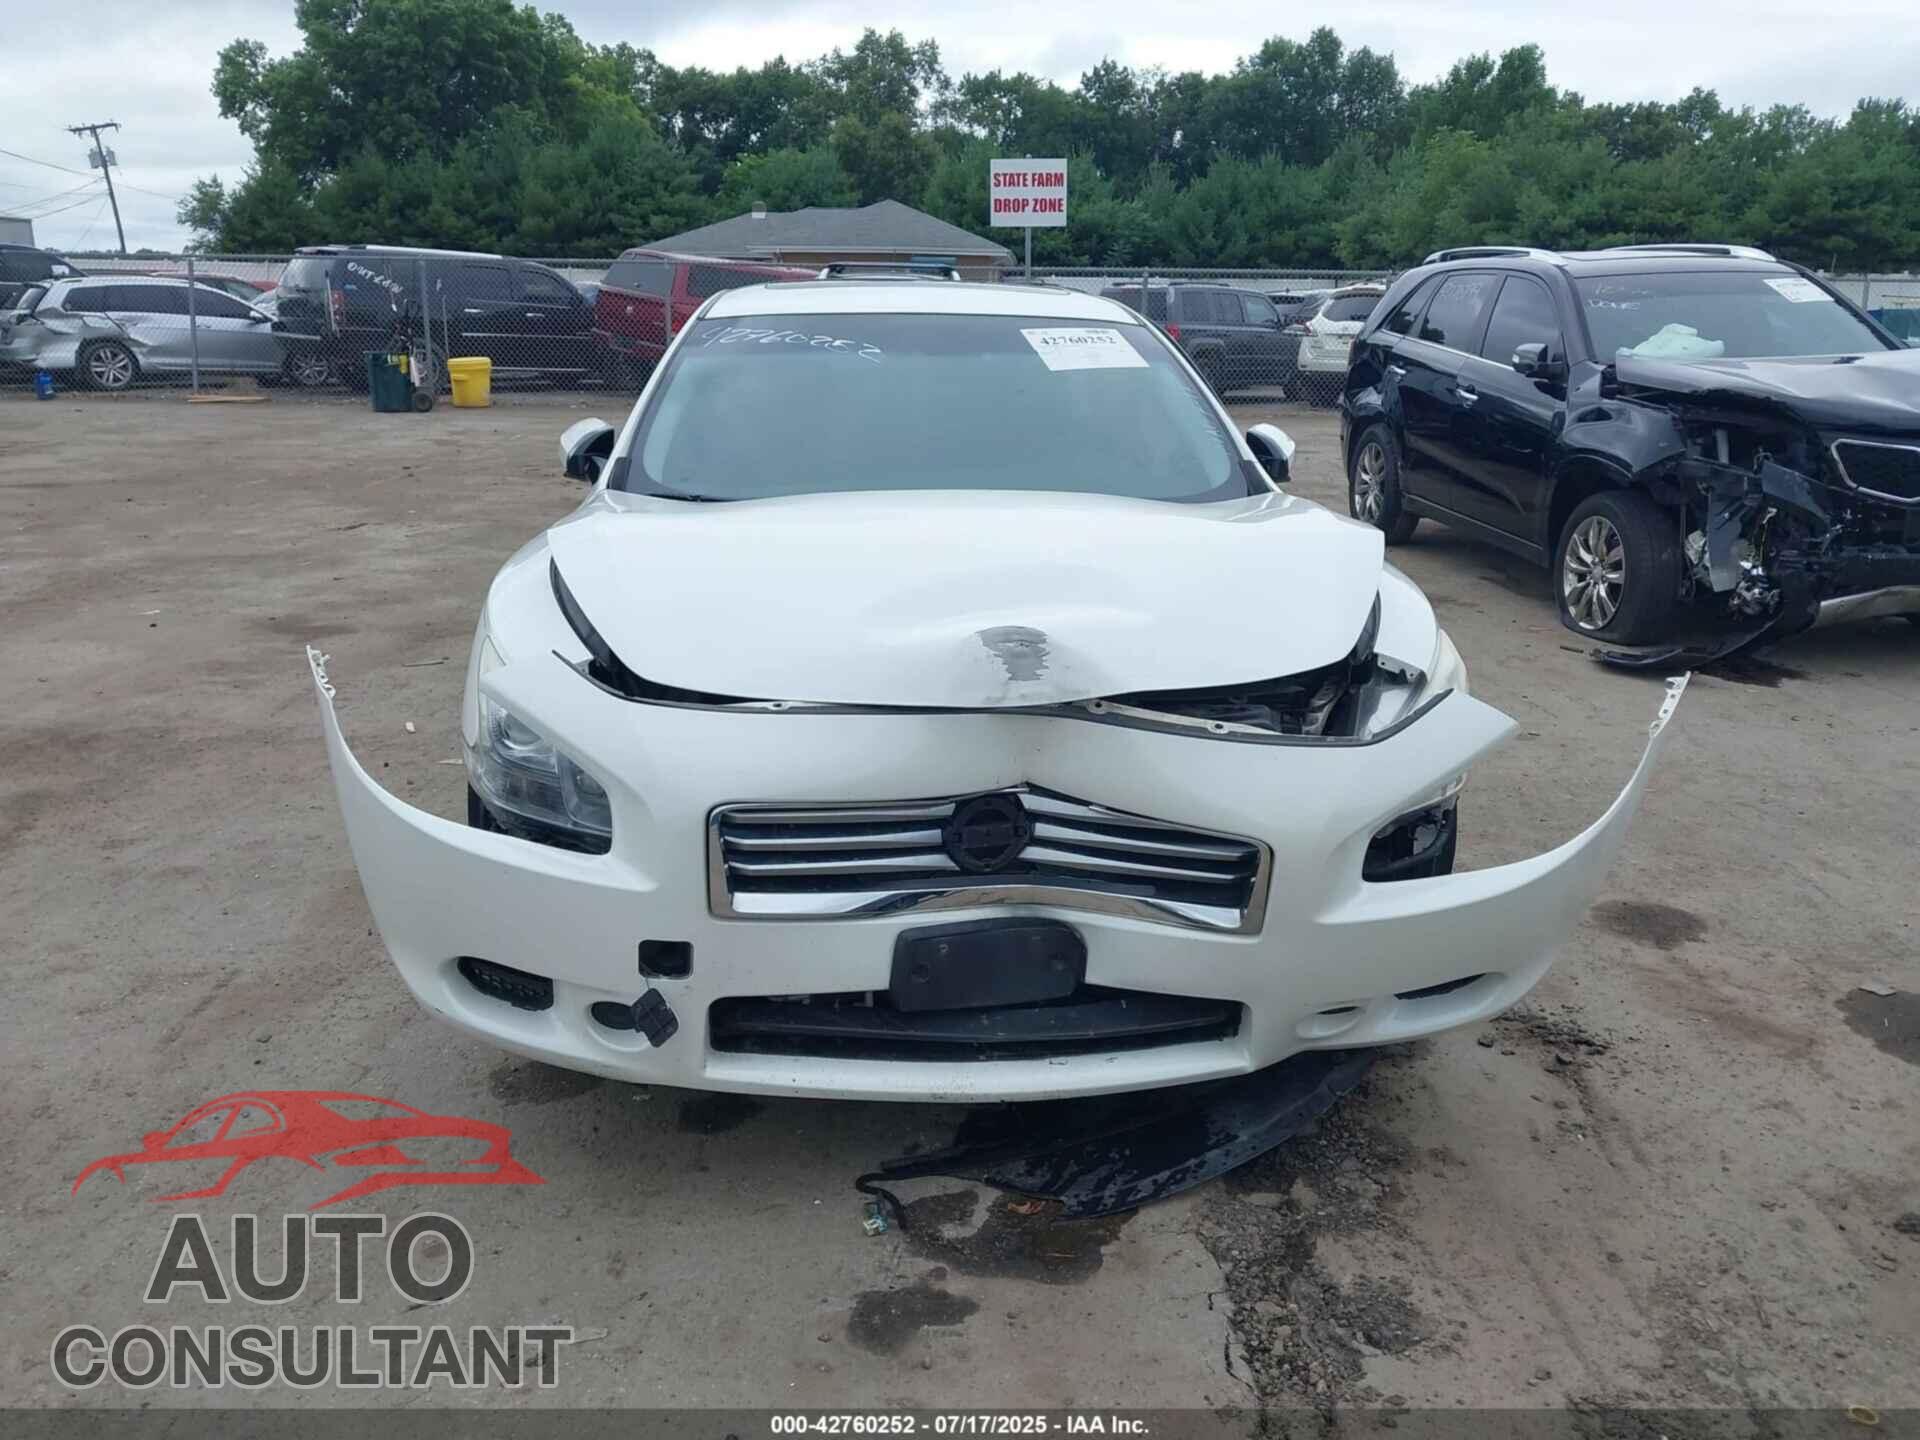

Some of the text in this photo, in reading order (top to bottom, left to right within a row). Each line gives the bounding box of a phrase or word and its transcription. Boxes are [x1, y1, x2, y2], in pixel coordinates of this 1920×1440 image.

[993, 172, 1064, 187] STATE FARM
[994, 198, 1064, 213] DROP ZONE
